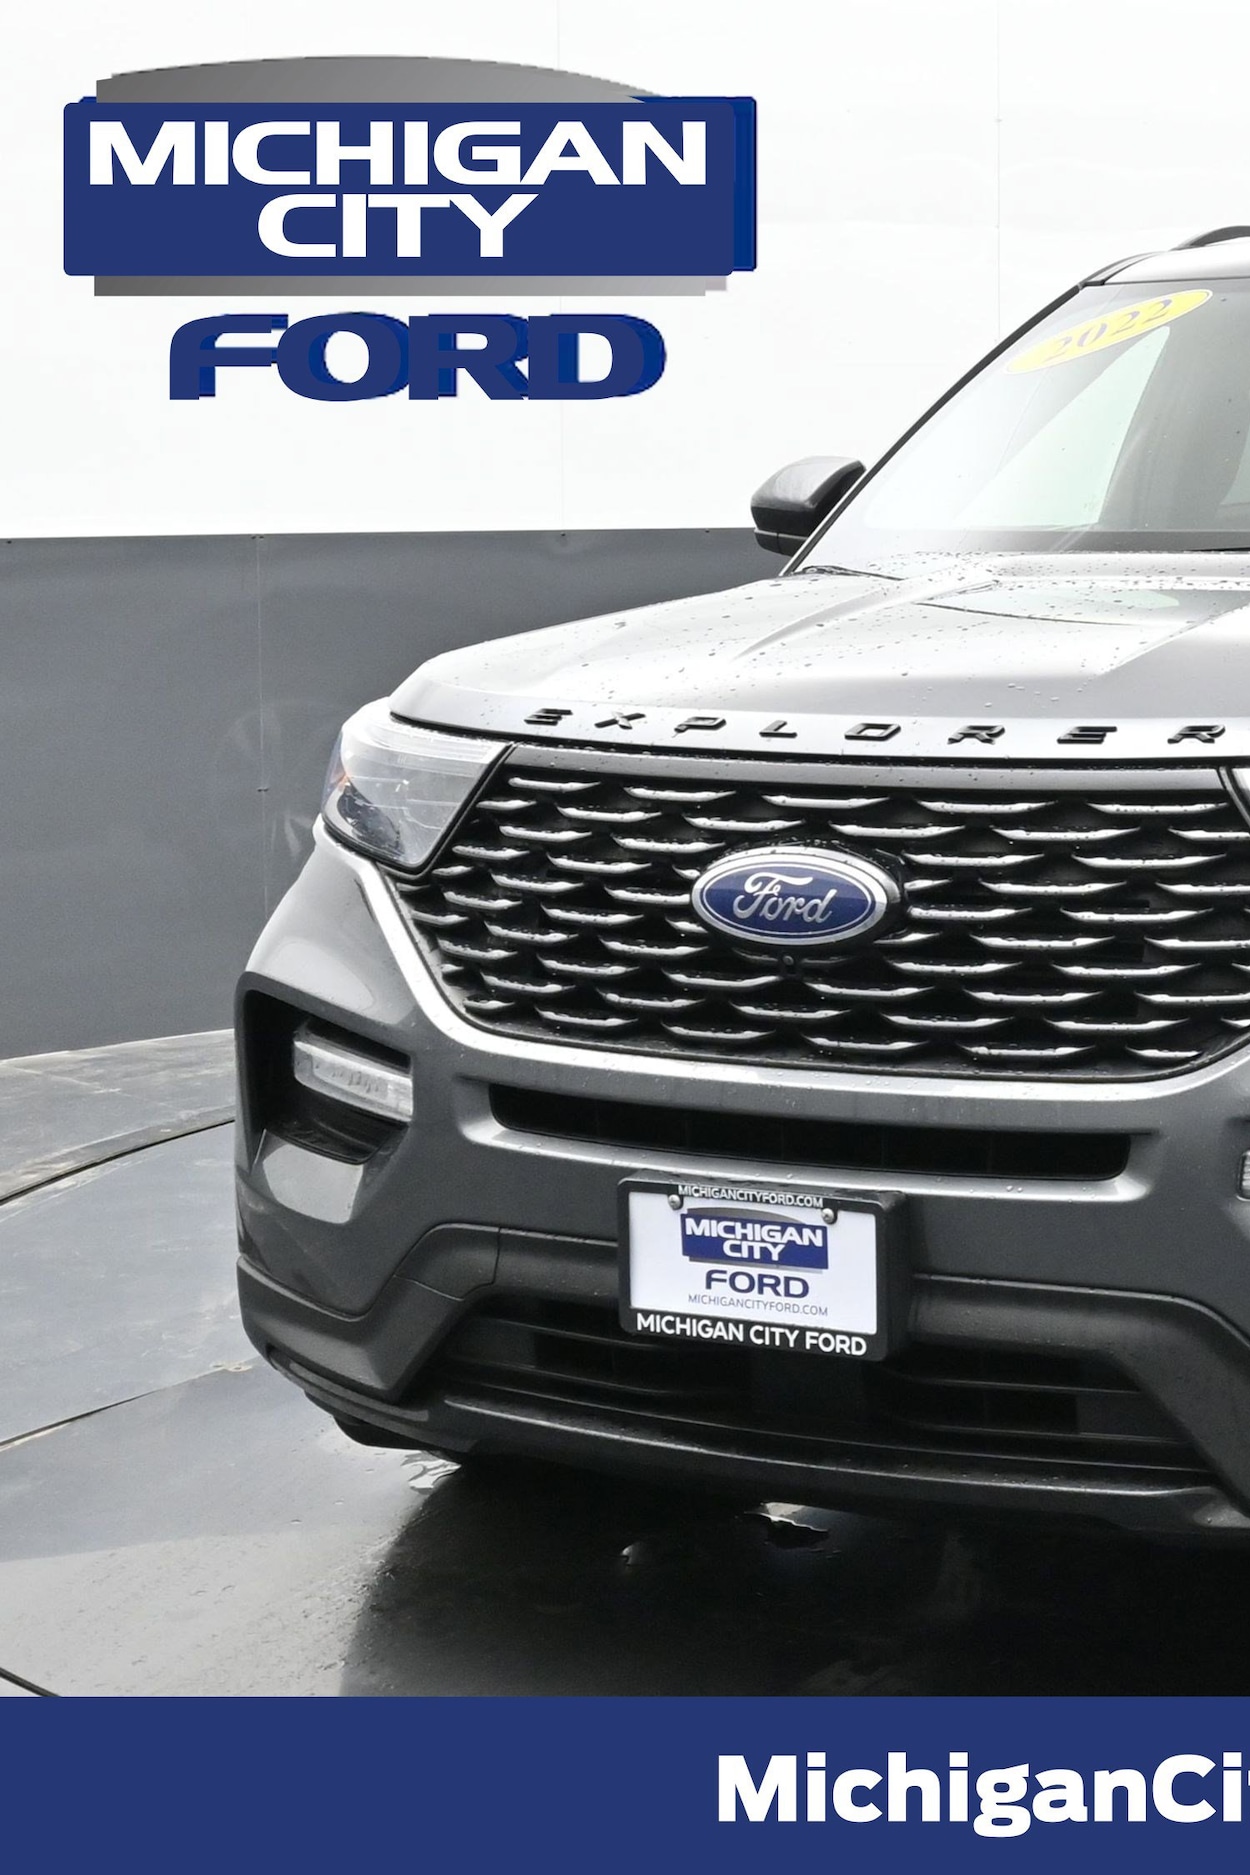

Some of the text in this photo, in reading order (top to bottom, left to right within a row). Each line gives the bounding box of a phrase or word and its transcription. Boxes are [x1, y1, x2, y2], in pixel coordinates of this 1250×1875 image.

[1041, 298, 1173, 363] 2022
[523, 707, 1226, 745] EXPLORER
[731, 871, 834, 925] Ford
[678, 1184, 823, 1208] MICHIGANCITYFORD.COM
[685, 1217, 823, 1247] MICHIGAN
[722, 1241, 786, 1262] CITY
[705, 1269, 809, 1299] FORD
[688, 1293, 829, 1317] MICHIGANCITYFORD.COM
[636, 1313, 868, 1357] MICHIGAN CITY FORD
